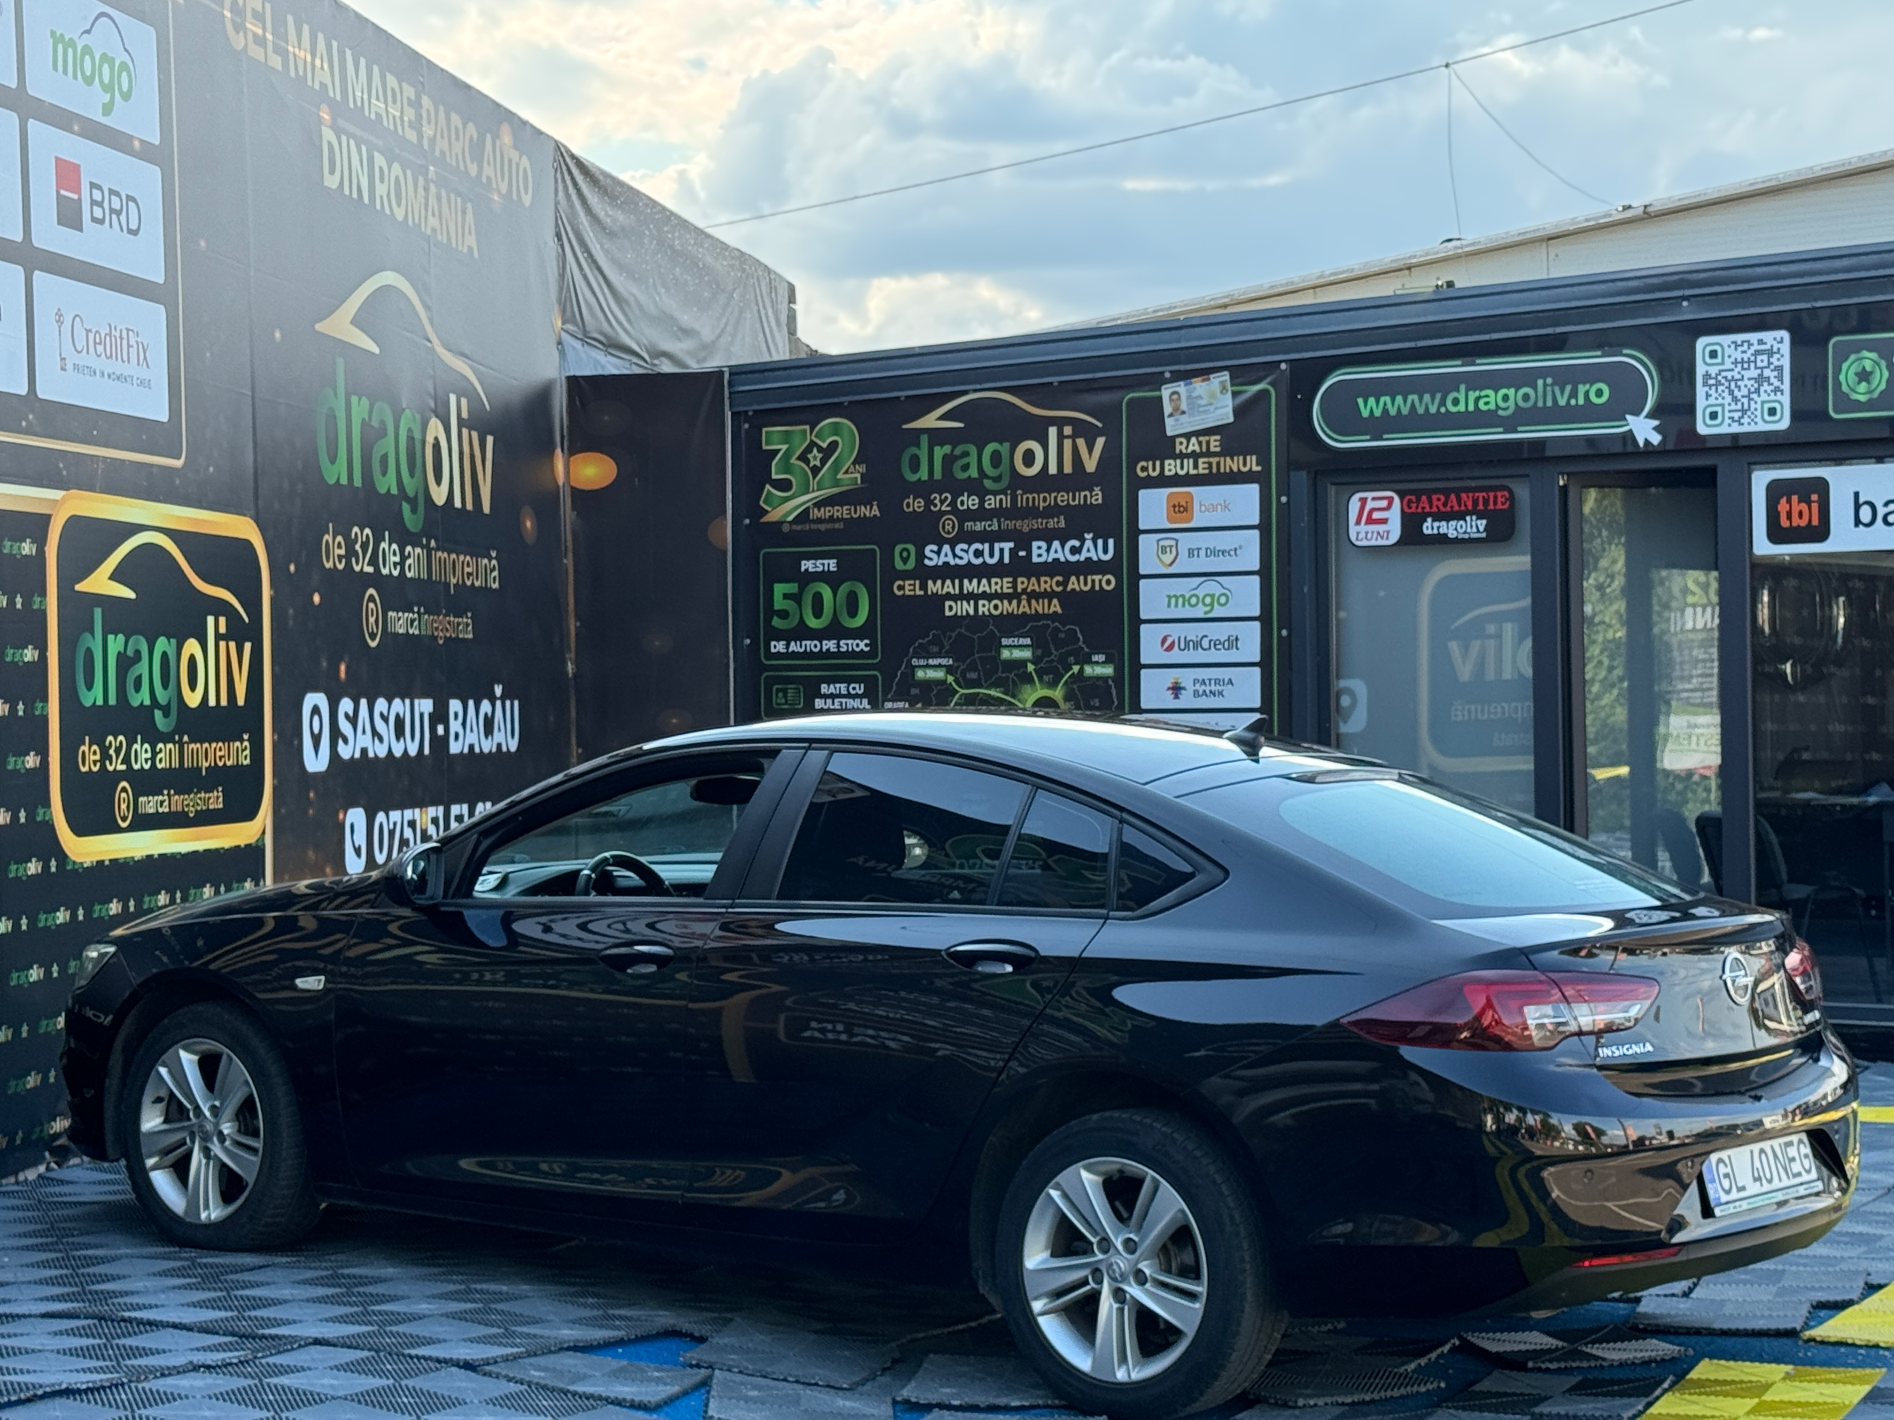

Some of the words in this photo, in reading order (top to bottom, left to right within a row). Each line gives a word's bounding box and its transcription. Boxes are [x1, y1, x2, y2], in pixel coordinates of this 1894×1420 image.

[50, 28, 134, 117] mogo
[223, 0, 282, 72] CEL
[286, 13, 342, 101] MAI
[345, 47, 418, 145] MARE
[421, 94, 478, 177] PARC
[482, 132, 533, 208] AUTO
[320, 124, 369, 205] DIN
[373, 149, 479, 259] ROMÂNIA
[89, 180, 142, 237] BRD
[70, 313, 151, 370] CreditFix
[1356, 377, 1611, 418] www.dragoliv.ro
[315, 356, 495, 533] dragoliv
[1175, 435, 1222, 454] RATE
[759, 417, 861, 512] 32
[848, 463, 867, 474] ANI
[901, 426, 1107, 491] dragoliv
[1136, 460, 1161, 478] CU
[1163, 455, 1263, 477] BULETINUL
[809, 501, 881, 520] ÎMPREUNĂ
[903, 495, 925, 513] de
[930, 493, 952, 511] 32
[956, 492, 980, 510] de
[984, 490, 1012, 510] ani
[1016, 486, 1103, 511] împreună
[1171, 501, 1189, 515] tbi
[1198, 499, 1232, 514] bank
[1354, 495, 1395, 527] 12
[1402, 490, 1510, 513] GARANTIE
[1777, 493, 1820, 529] tbi
[963, 518, 999, 532] marcă
[1000, 516, 1067, 533] înregistrată
[1355, 530, 1391, 542] LUNI
[1422, 515, 1488, 539] dragoliv
[321, 522, 346, 571] de
[350, 525, 375, 574] 32
[378, 531, 401, 577] de
[404, 537, 428, 580] ani
[431, 540, 500, 594] împreună
[923, 541, 1015, 567] SASCUT
[1031, 532, 1115, 564] BACĂU
[1160, 545, 1174, 555] BT
[1187, 547, 1202, 559] BT
[801, 559, 838, 573] PESTE
[893, 579, 925, 596] CEL
[927, 579, 960, 595] MAI
[963, 577, 1013, 595] MARE
[1017, 576, 1064, 593] PARC
[1066, 574, 1117, 592] AUTO
[771, 580, 870, 630] 500
[944, 600, 976, 617] DIN
[978, 596, 1063, 616] ROMÂNIA
[1166, 592, 1231, 615] mogo
[387, 606, 420, 635] marcă
[420, 610, 474, 645] înregistrată
[770, 641, 787, 653] DE
[789, 640, 821, 653] AUTO
[822, 640, 838, 652] PE
[839, 639, 871, 652] STOC
[1177, 634, 1240, 652] UniCredit
[74, 606, 253, 733] dragoliv
[820, 683, 848, 695] RATE
[849, 683, 865, 694] CU
[1192, 677, 1235, 688] PATRIA
[1192, 689, 1226, 699] BANK
[814, 698, 872, 710] BULETINUL
[337, 696, 434, 760] SASCUT
[448, 683, 520, 754] BACĂU
[78, 736, 102, 773] de
[105, 734, 128, 772] 32
[130, 734, 152, 771] de
[155, 734, 180, 770] ani
[182, 731, 252, 776] împreună
[138, 789, 169, 815] marcă
[170, 786, 225, 818] înregistrată
[1598, 1041, 1655, 1059] INSIGNIA
[1715, 1154, 1747, 1196] GL
